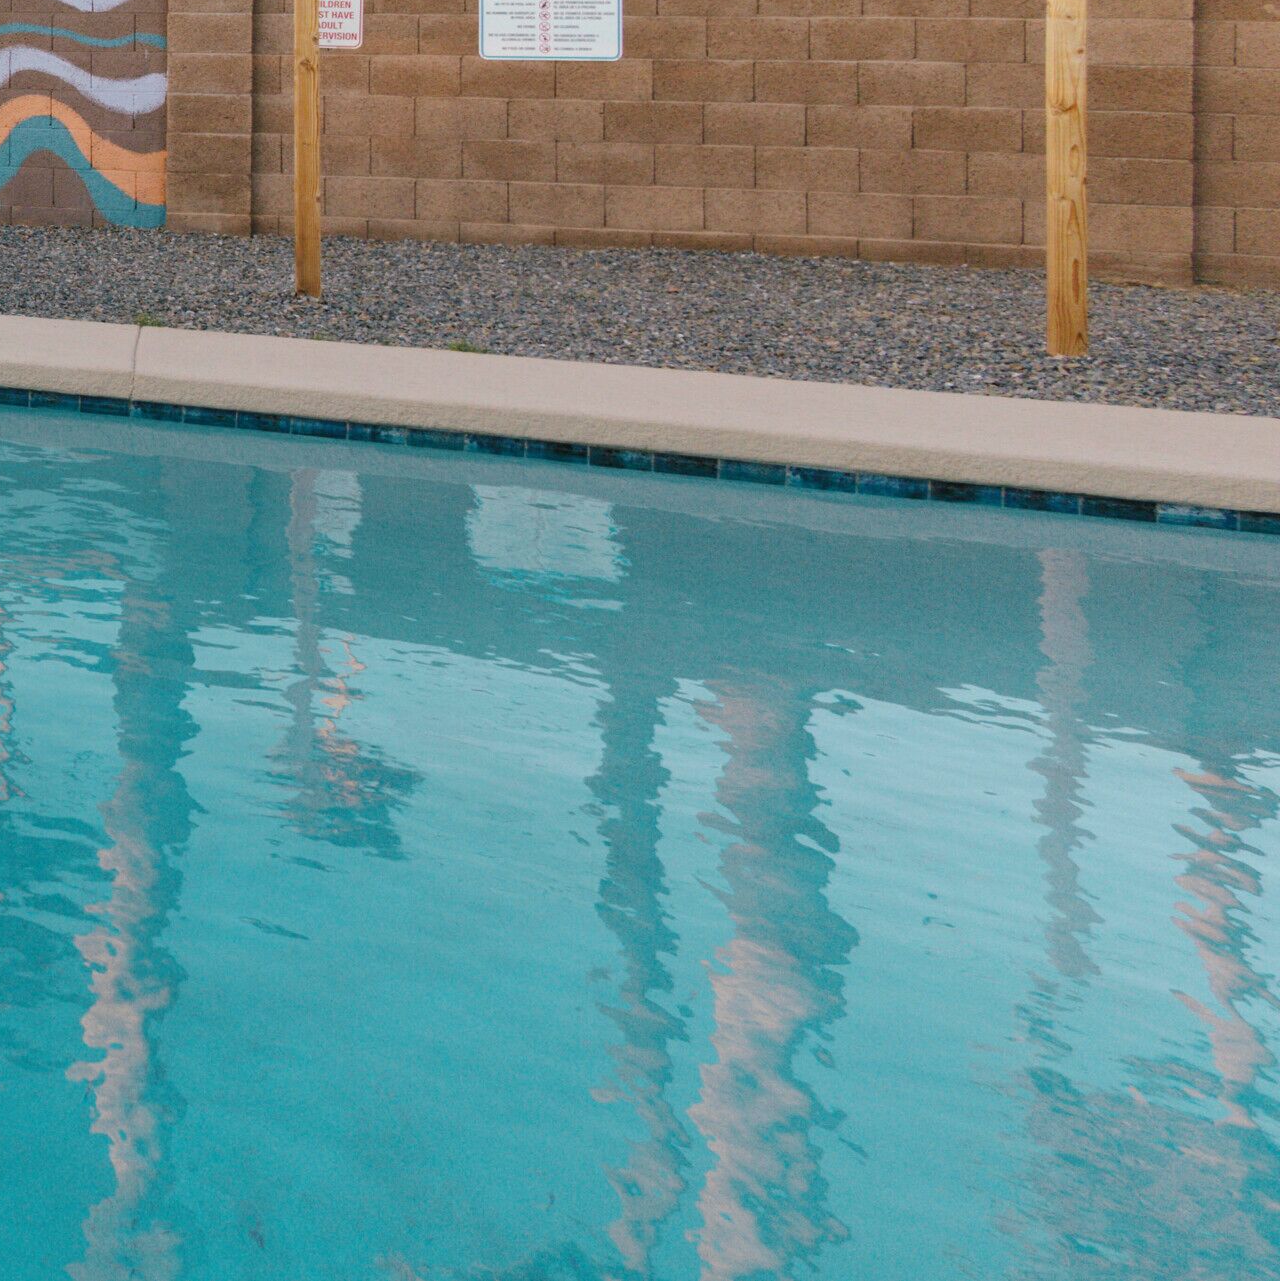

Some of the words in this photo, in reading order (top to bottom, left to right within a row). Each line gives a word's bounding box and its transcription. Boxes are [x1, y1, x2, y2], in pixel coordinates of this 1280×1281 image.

[318, 11, 330, 19] ST
[331, 11, 355, 19] HAVE
[318, 32, 357, 40] ERVISION
